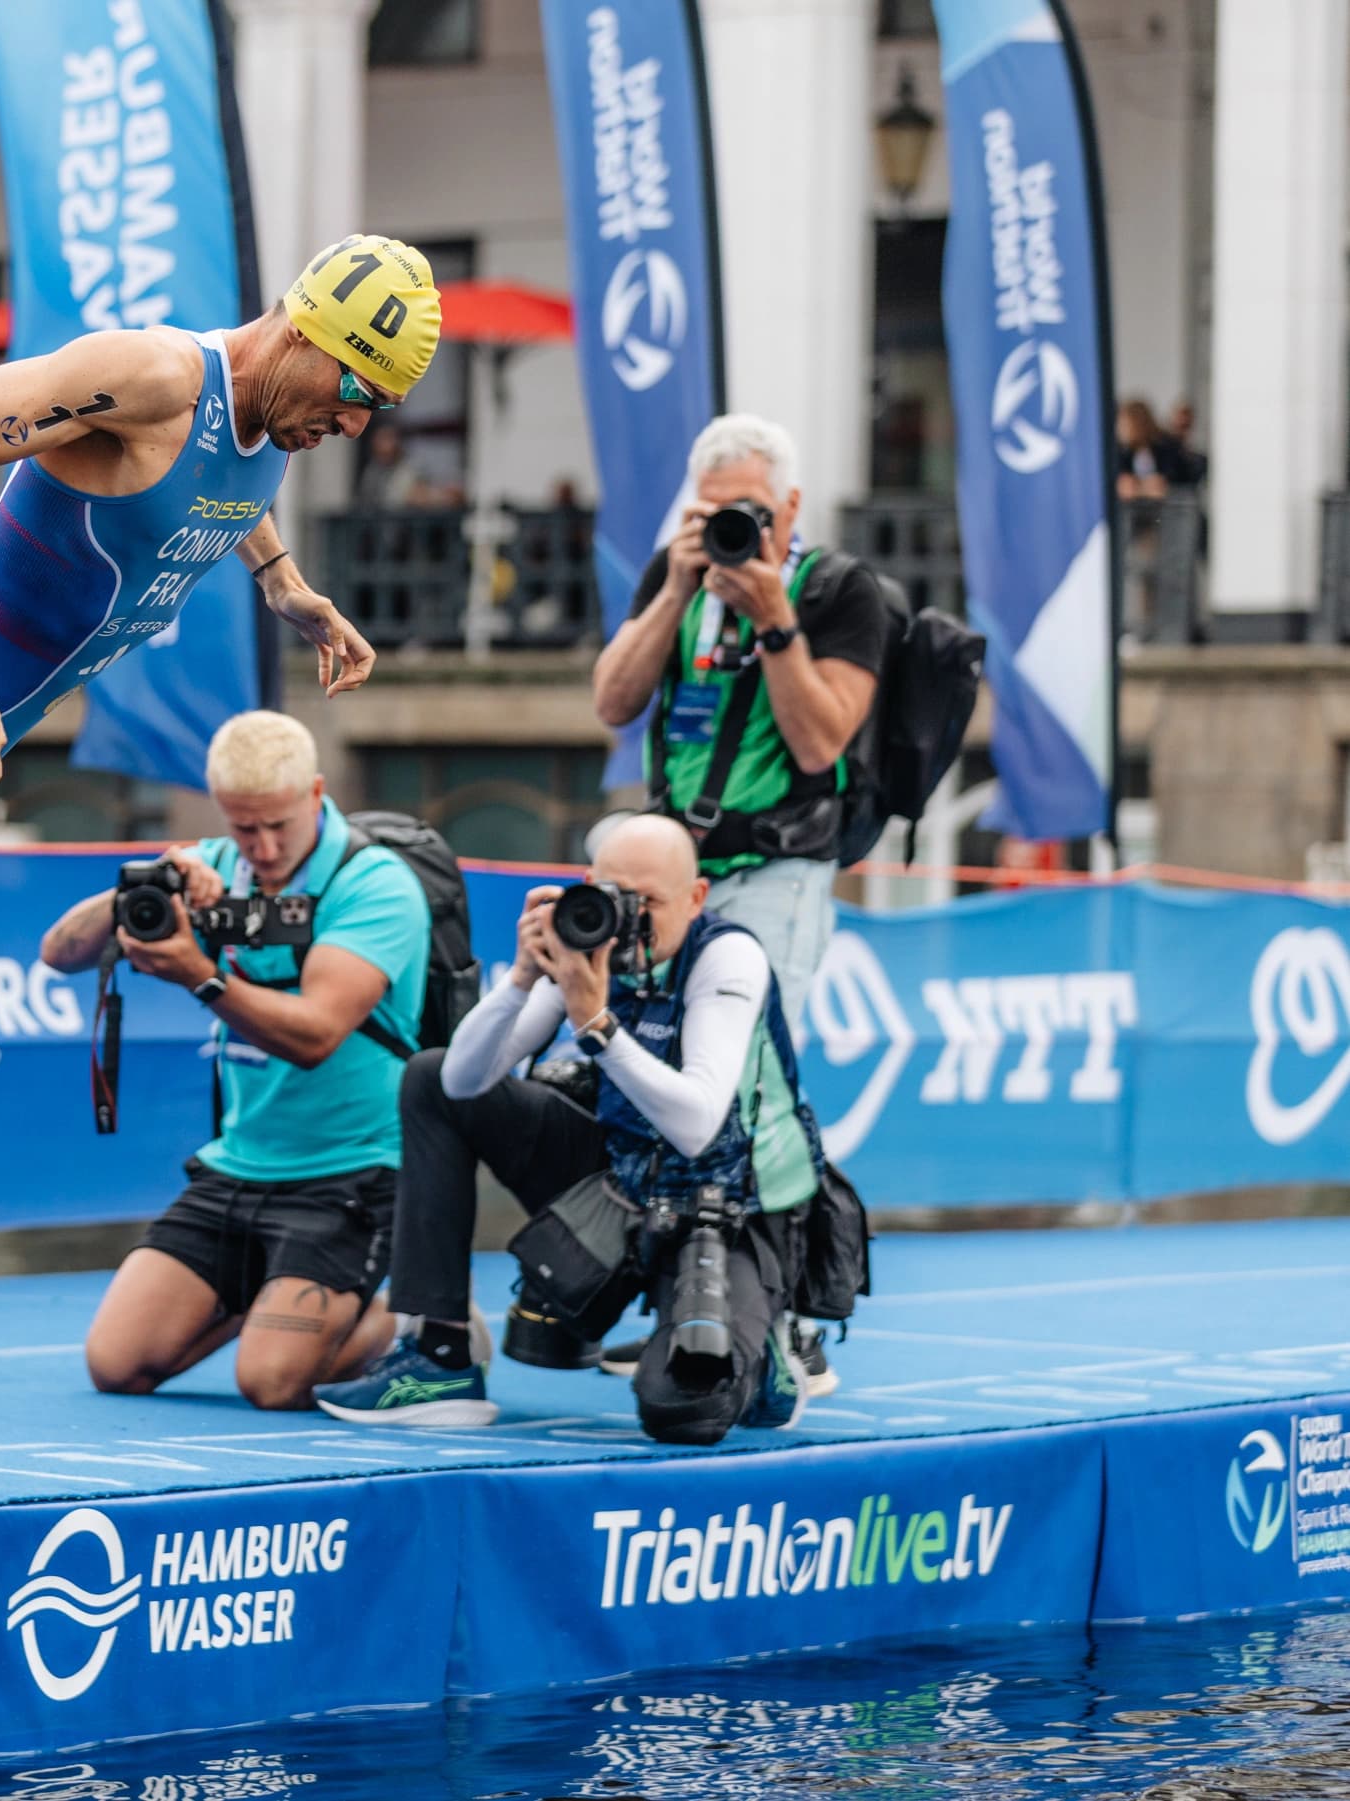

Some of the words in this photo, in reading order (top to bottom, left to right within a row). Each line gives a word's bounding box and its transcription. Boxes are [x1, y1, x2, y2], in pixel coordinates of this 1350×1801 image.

[187, 496, 265, 520] POISSY
[137, 572, 192, 607] FRA
[920, 970, 1138, 1104] NTT
[151, 1517, 350, 1587] HAMBURG
[593, 1493, 1014, 1609] Triathlonlive.tv
[148, 1588, 296, 1653] WASSER
